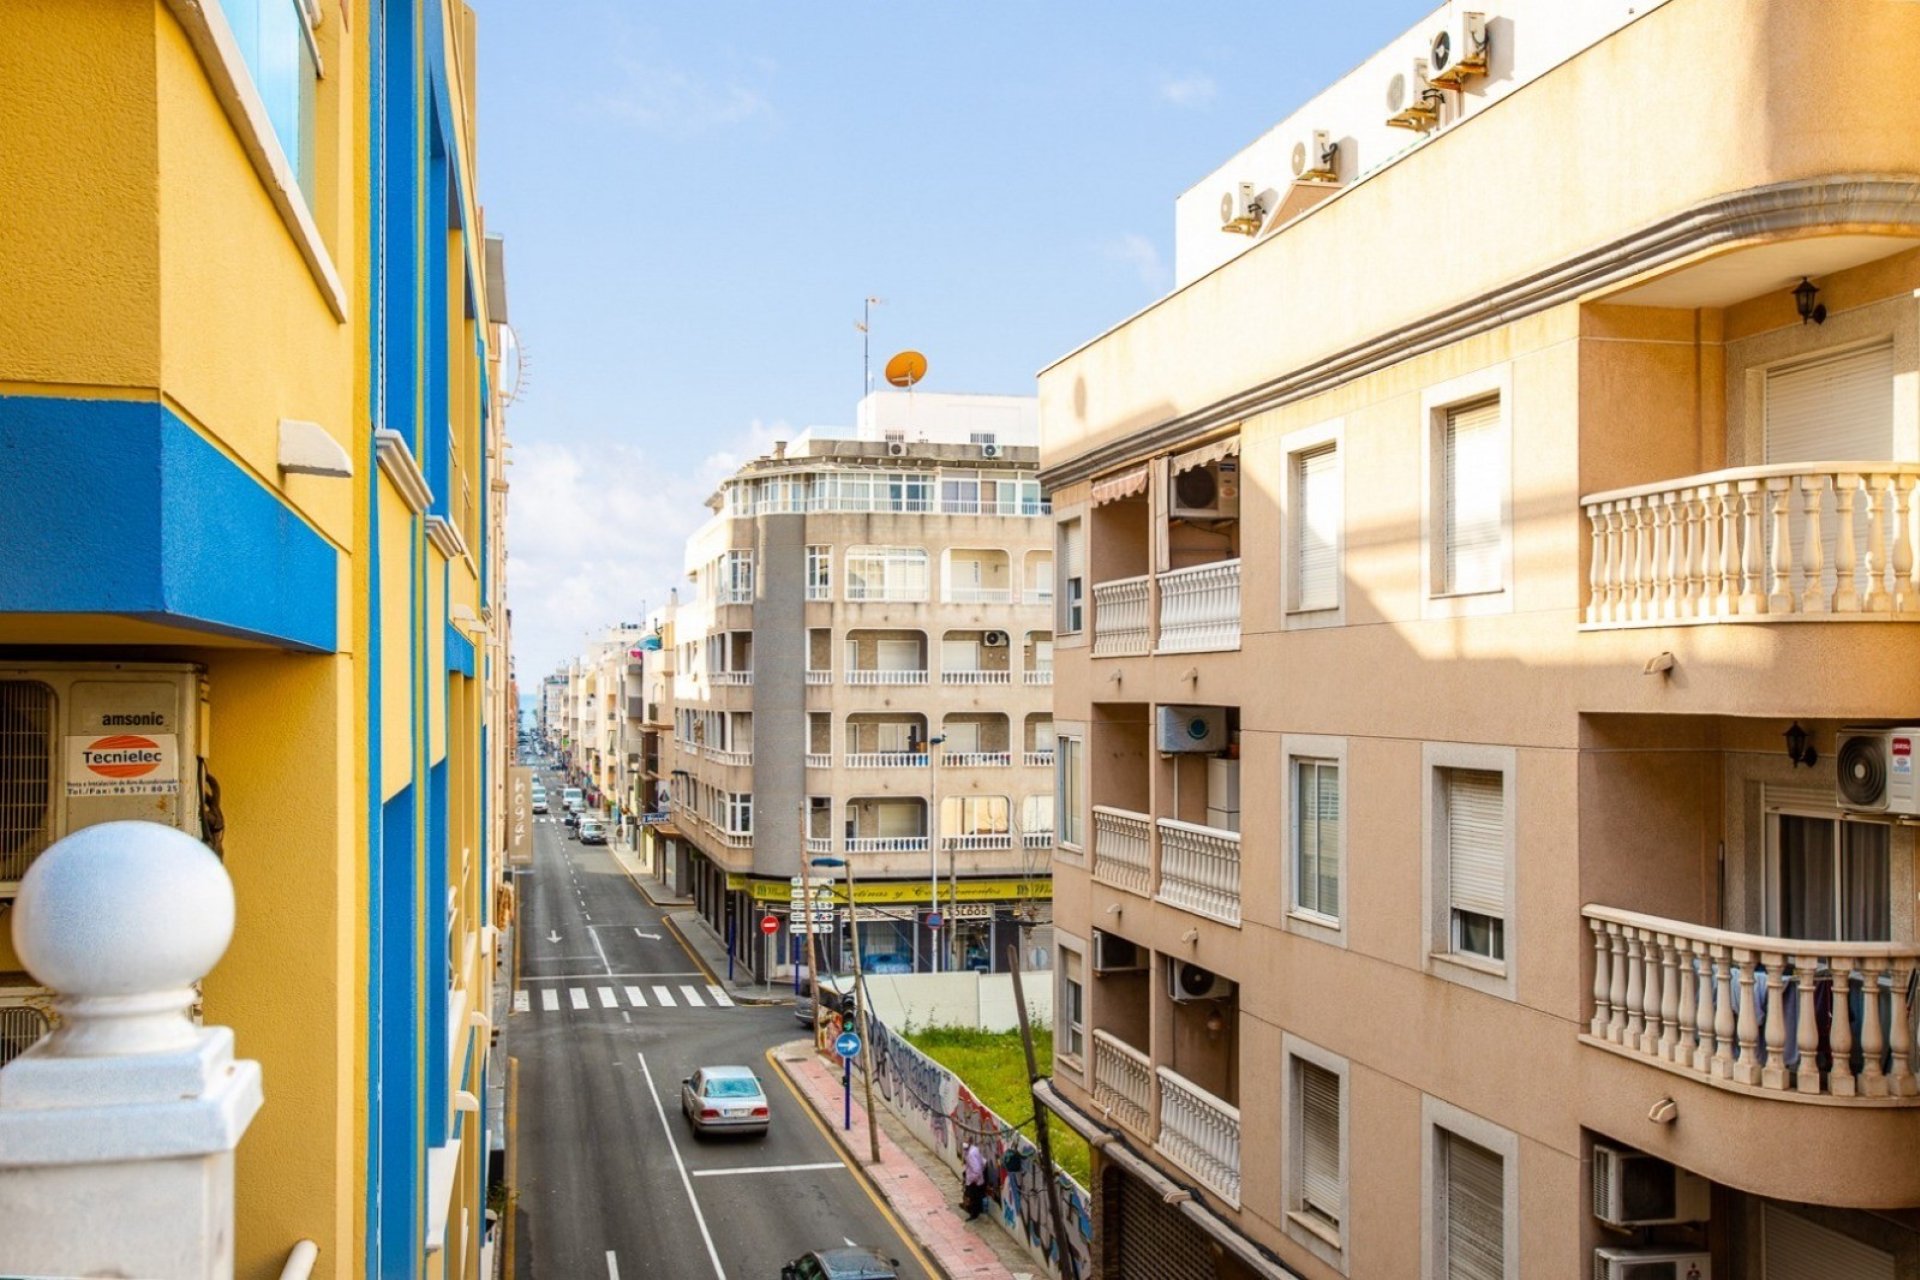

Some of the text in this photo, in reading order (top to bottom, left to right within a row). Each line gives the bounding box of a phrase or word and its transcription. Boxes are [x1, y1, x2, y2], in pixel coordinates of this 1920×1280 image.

[102, 711, 164, 726] amsonic
[82, 750, 162, 764] Tecnielec
[514, 777, 526, 846] hogar
